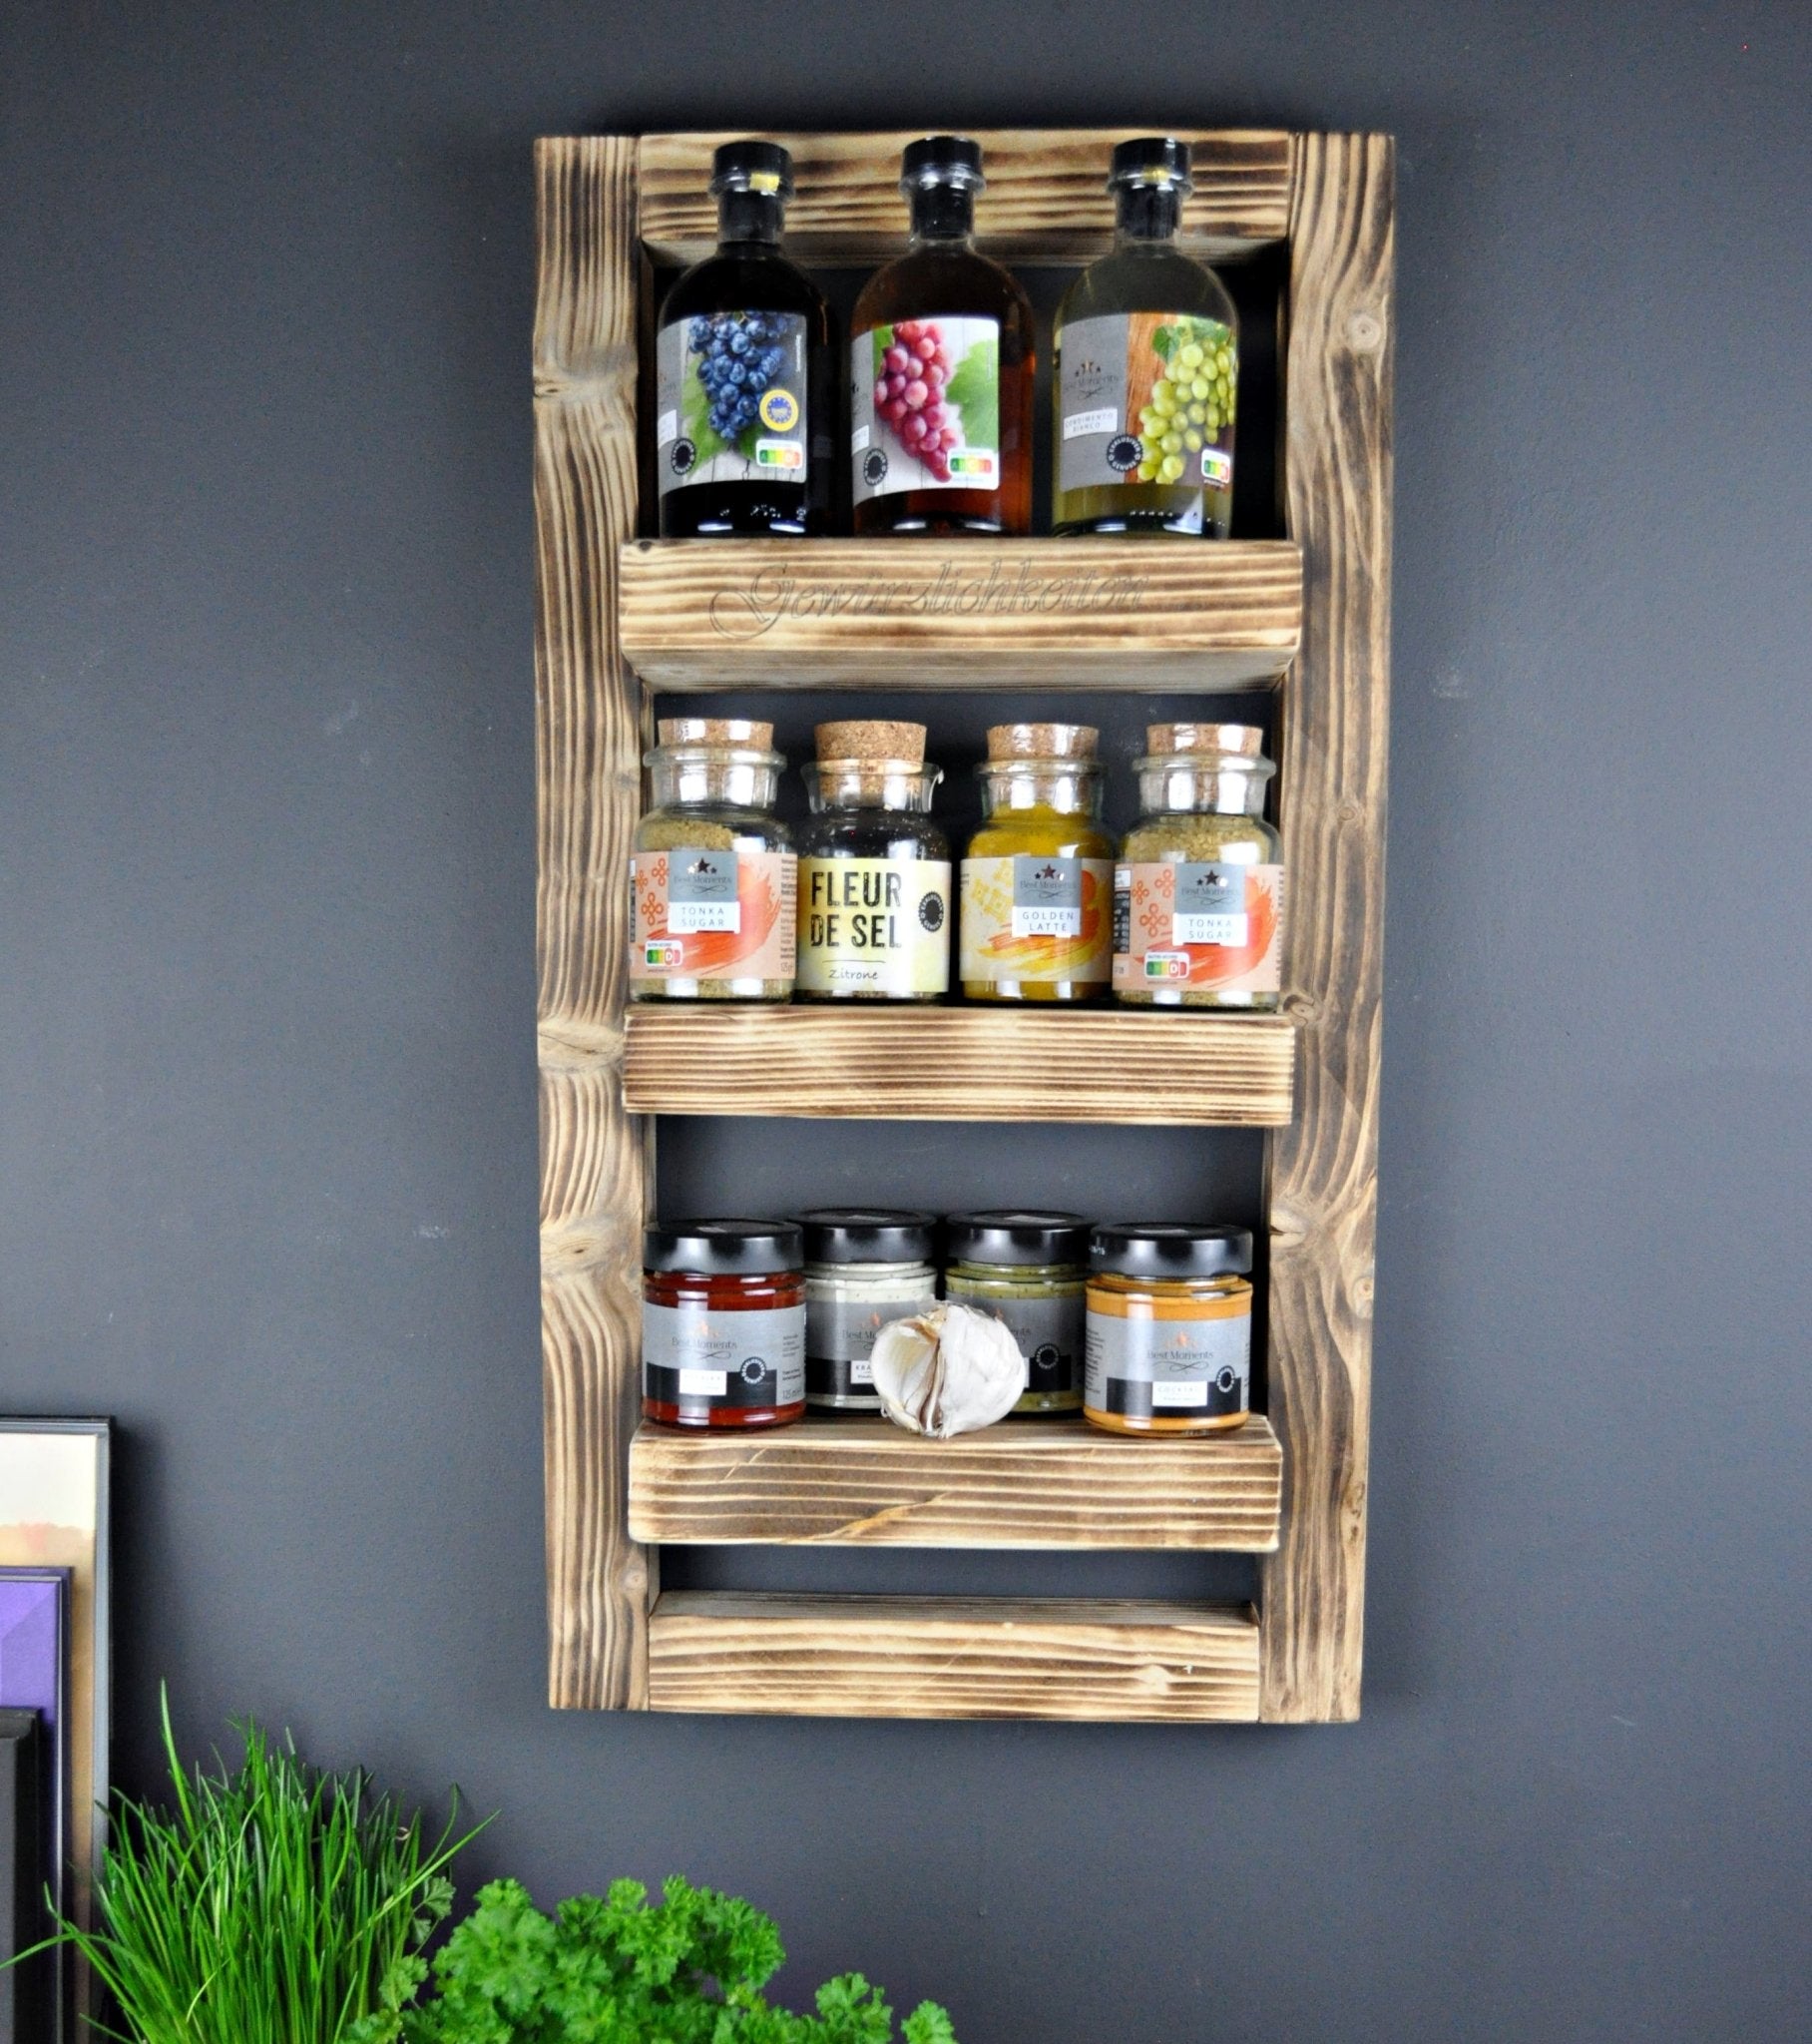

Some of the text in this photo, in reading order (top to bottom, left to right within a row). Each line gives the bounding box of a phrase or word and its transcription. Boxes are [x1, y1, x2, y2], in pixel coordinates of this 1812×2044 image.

[811, 871, 902, 907] FLEUR
[680, 906, 724, 916] TONKA
[1023, 911, 1074, 920] GOLDEN
[680, 918, 725, 927] SUGAR
[1188, 918, 1232, 927] TONKA
[810, 915, 902, 947] DE SEL
[1188, 930, 1232, 939] SUGAR
[828, 969, 879, 980] Zitrone
[1170, 1350, 1214, 1360] Moments
